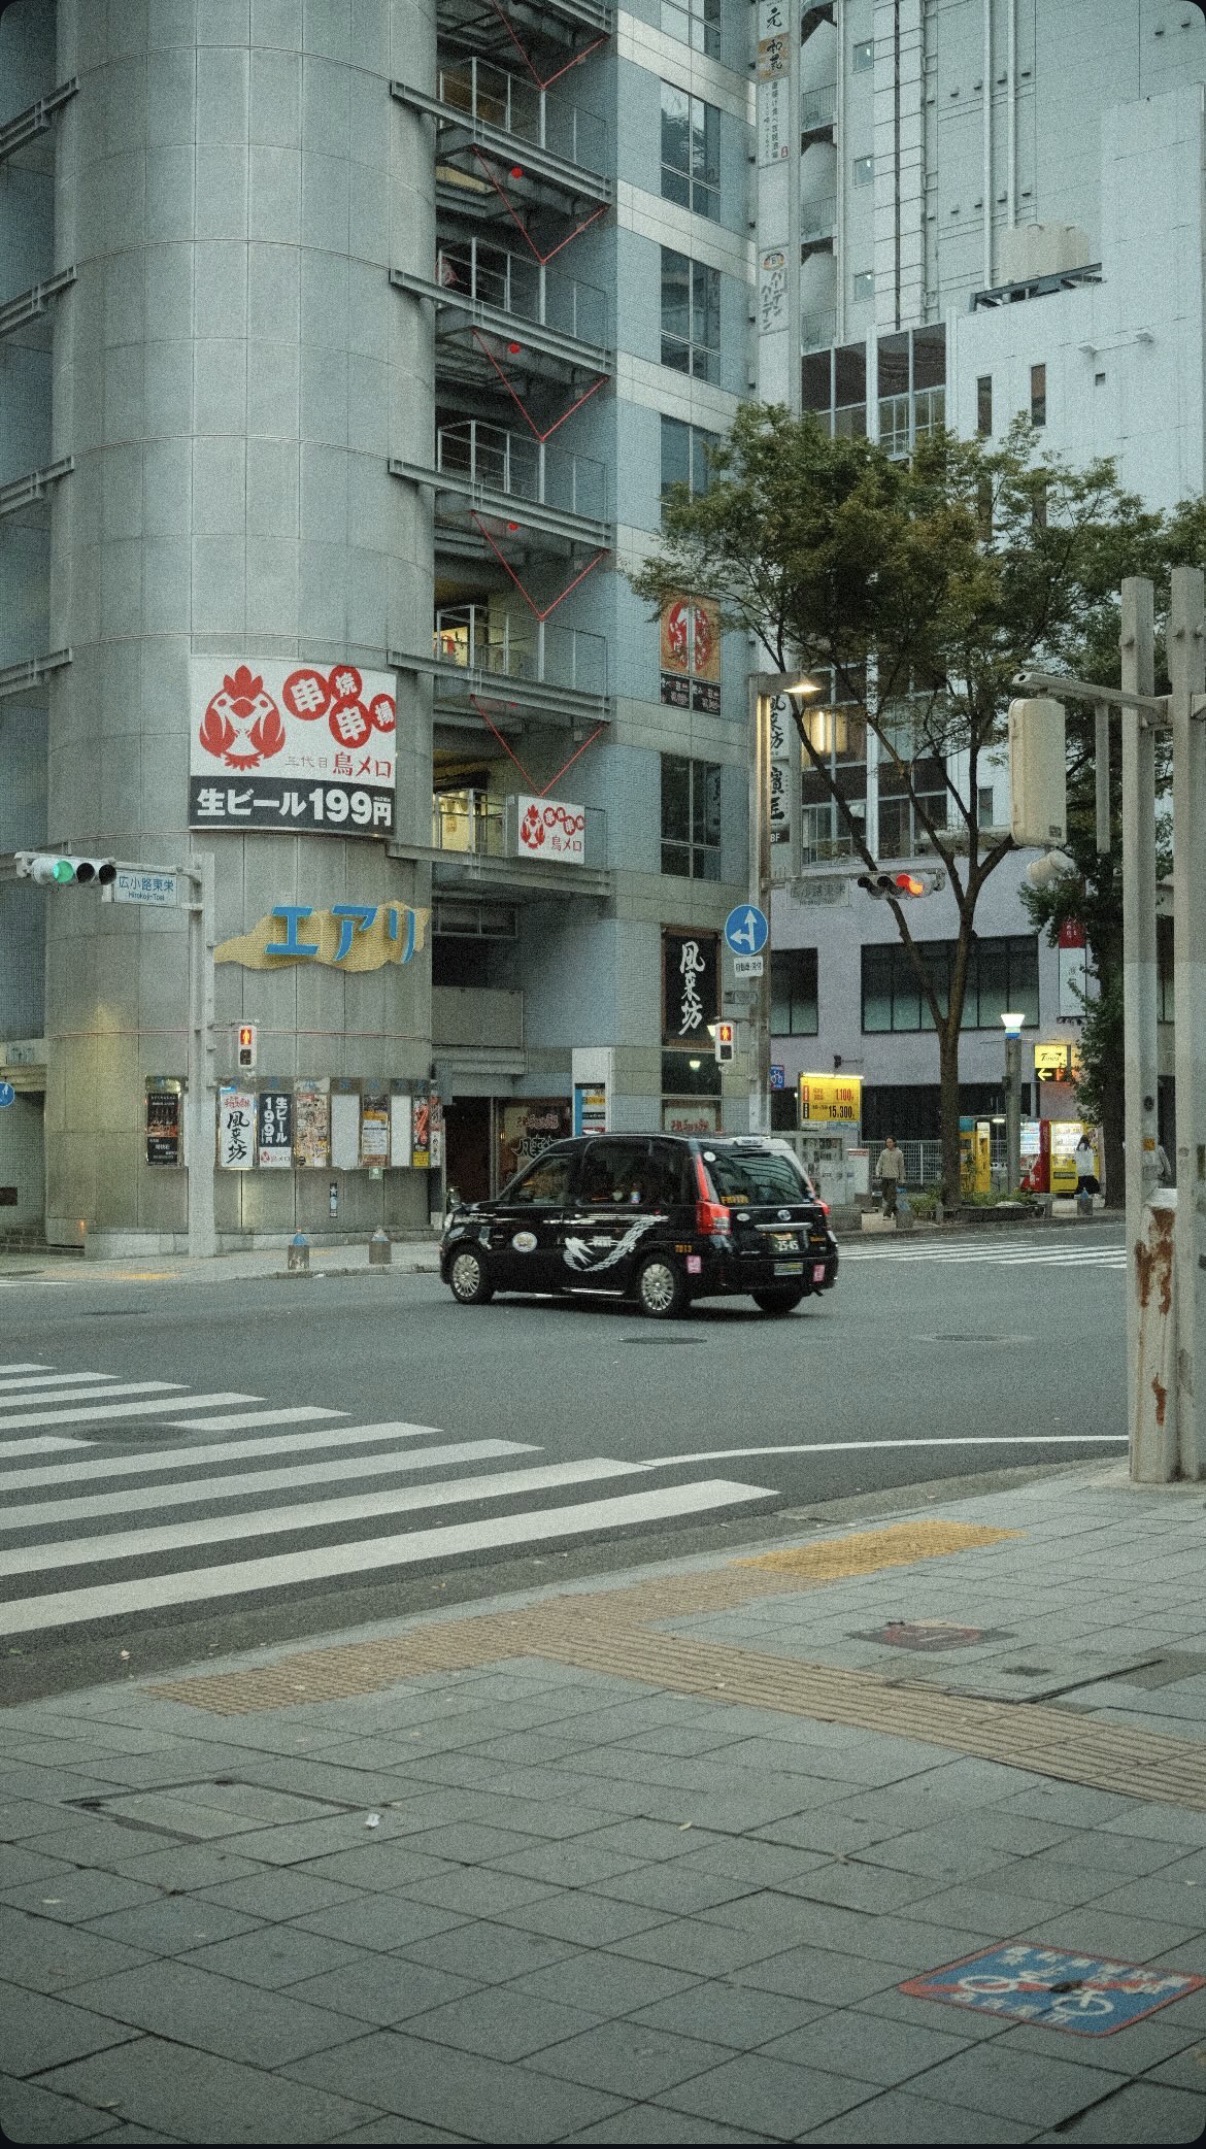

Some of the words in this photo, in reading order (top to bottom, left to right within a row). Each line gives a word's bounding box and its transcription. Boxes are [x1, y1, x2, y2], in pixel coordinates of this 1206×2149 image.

[197, 787, 392, 827] 生ビール199円
[119, 876, 174, 892] 広小路東栄
